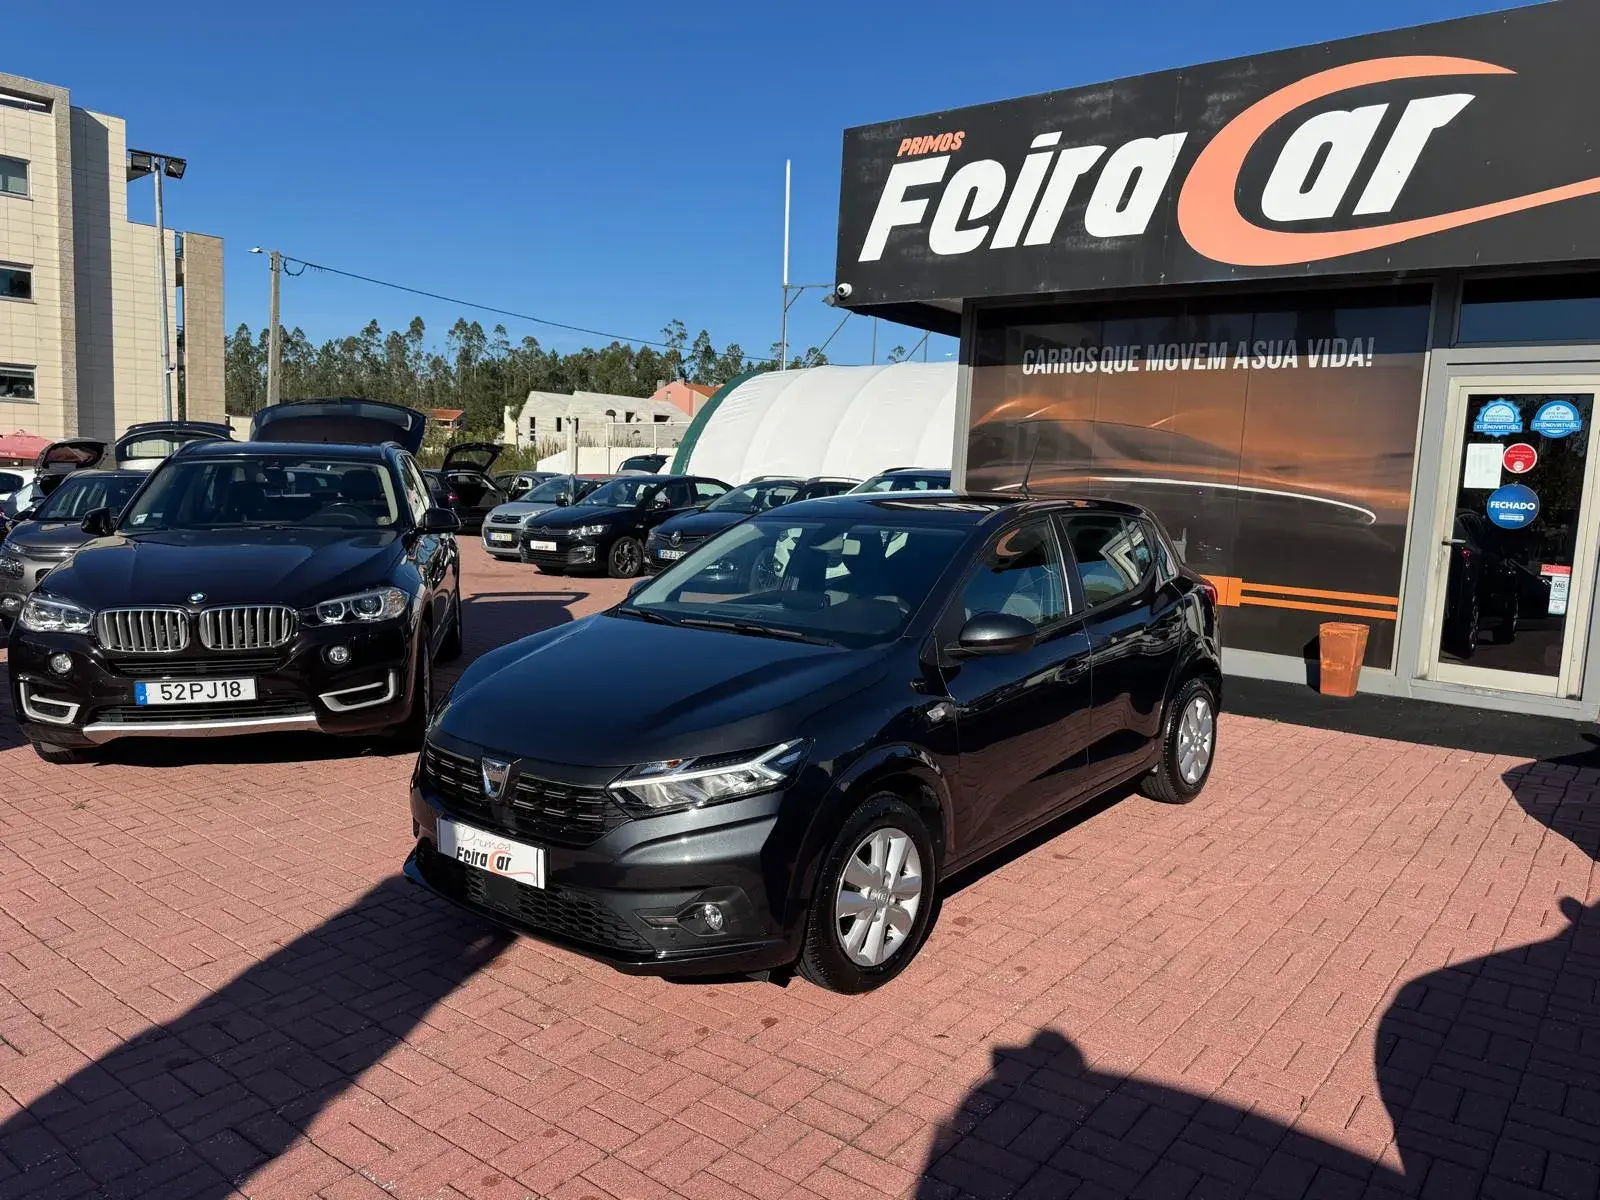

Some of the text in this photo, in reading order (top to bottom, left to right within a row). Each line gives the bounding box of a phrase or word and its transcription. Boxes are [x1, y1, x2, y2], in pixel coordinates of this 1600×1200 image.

[897, 131, 965, 157] PRIMOS
[1022, 346, 1099, 375] CARROS
[1100, 345, 1140, 375] QUE
[1145, 342, 1228, 372] MOVEM
[1307, 337, 1376, 368] VIDA!
[1490, 501, 1536, 511] FECHADO
